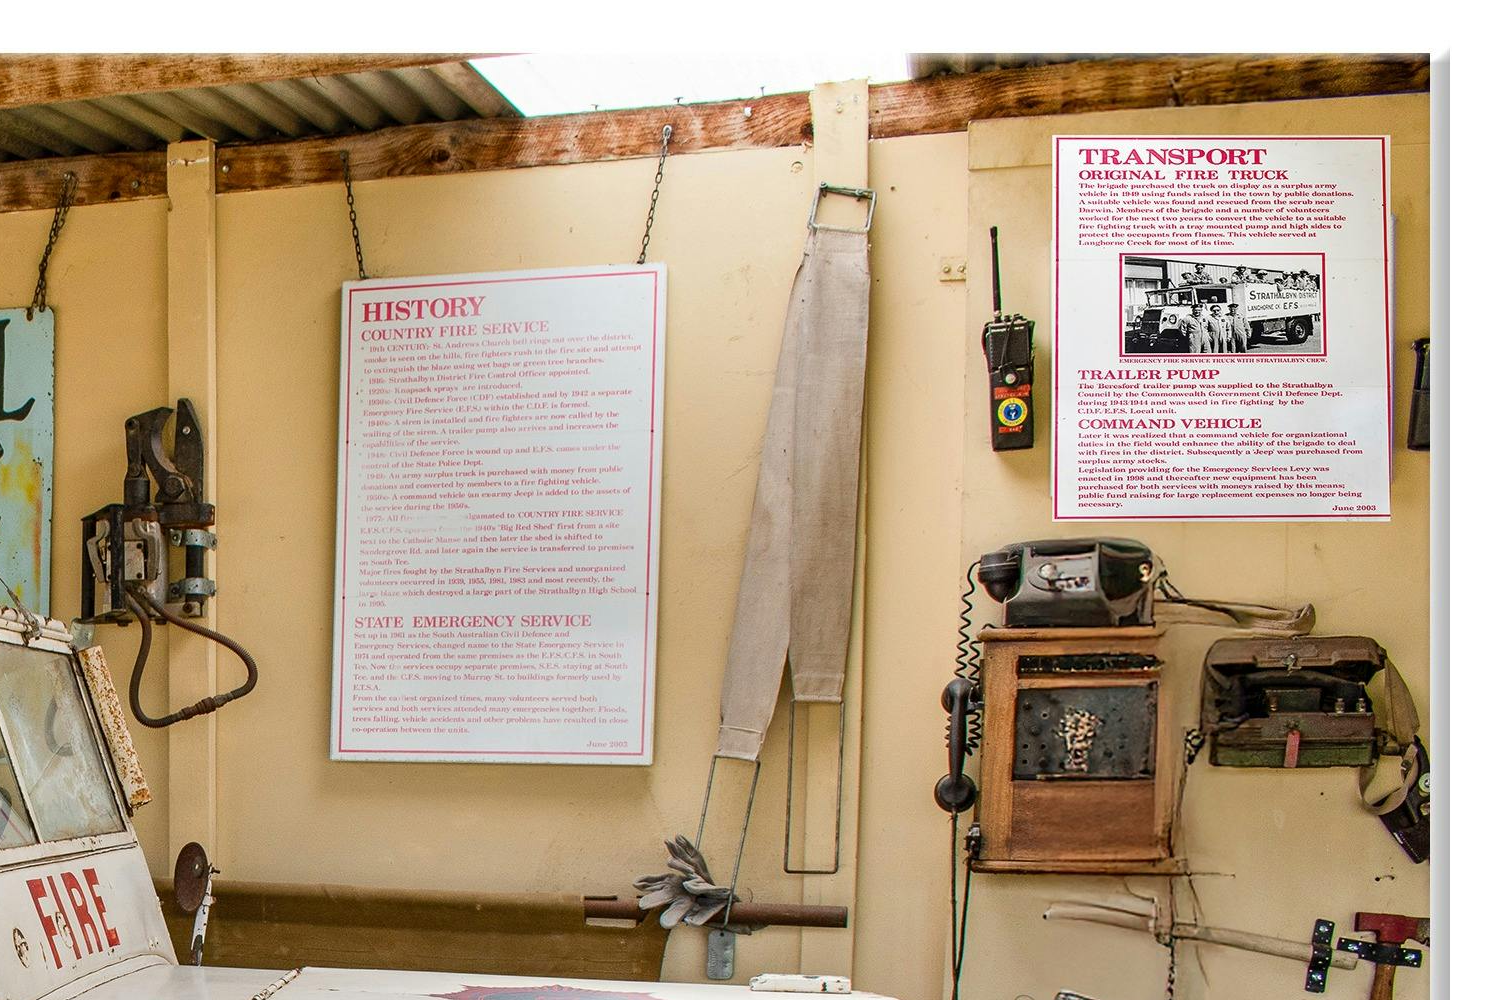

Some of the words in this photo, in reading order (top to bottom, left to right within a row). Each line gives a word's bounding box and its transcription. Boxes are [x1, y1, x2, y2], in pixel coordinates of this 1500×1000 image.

[1078, 148, 1267, 165] TRANSPORT
[1078, 170, 1166, 180] ORIGINAL
[1174, 170, 1219, 180] FIRE
[1227, 170, 1288, 180] TRUCK
[1096, 182, 1129, 190] brigade
[1230, 182, 1260, 190] display
[1280, 182, 1313, 190] surplus
[1141, 190, 1165, 198] using
[1272, 190, 1283, 198] by
[1284, 190, 1310, 198] public
[362, 296, 486, 323] HISTORY
[361, 326, 435, 342] COUNTRY
[439, 324, 477, 337] FIRE
[482, 320, 549, 335] SERVICE
[1077, 369, 1161, 380] TRAILER
[1166, 369, 1220, 380] PUMP
[1112, 391, 1124, 399] by
[1078, 418, 1176, 429] COMMAND
[1180, 418, 1262, 429] VEHICLE
[1078, 466, 1126, 474] Legislation
[1128, 466, 1171, 474] providing
[1289, 465, 1311, 473] Levy
[1078, 492, 1105, 500] public
[1201, 491, 1253, 499] replacement
[1337, 490, 1362, 498] being
[516, 510, 560, 519] COUNTRY
[561, 509, 584, 518] FIRE
[584, 508, 624, 517] SERVICE
[354, 616, 404, 628] STATE
[412, 615, 515, 628] EMERGENCY
[520, 614, 592, 627] SERVICE
[26, 868, 120, 969] FIRE
